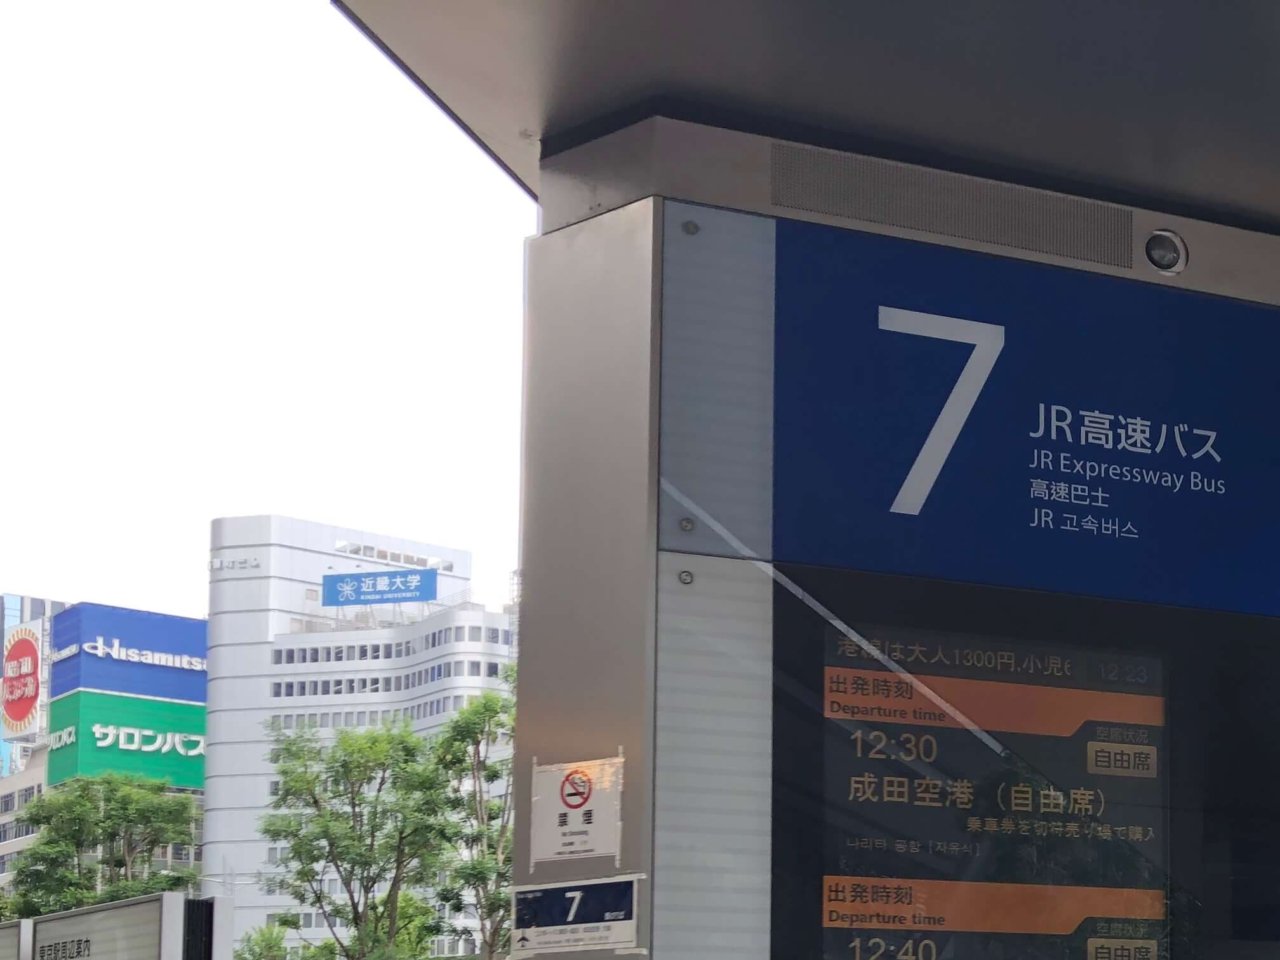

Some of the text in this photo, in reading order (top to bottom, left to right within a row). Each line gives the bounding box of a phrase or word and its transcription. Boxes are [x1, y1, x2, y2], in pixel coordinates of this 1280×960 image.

[879, 305, 1005, 515] 7
[1029, 403, 1222, 462] JR高速バス
[1029, 449, 1226, 494] JR Expressway Bus
[1030, 478, 1109, 508] 高速巴士
[1029, 508, 1139, 539] JR 고속버스
[361, 574, 421, 591] 近畿大学
[829, 675, 913, 699] 出発時刻
[830, 701, 946, 722] Departure time
[851, 729, 937, 763] 12:30
[1095, 749, 1151, 771] 自由席
[565, 891, 583, 921] 7
[828, 884, 913, 905] 出発時刻
[829, 909, 945, 926] Departure time
